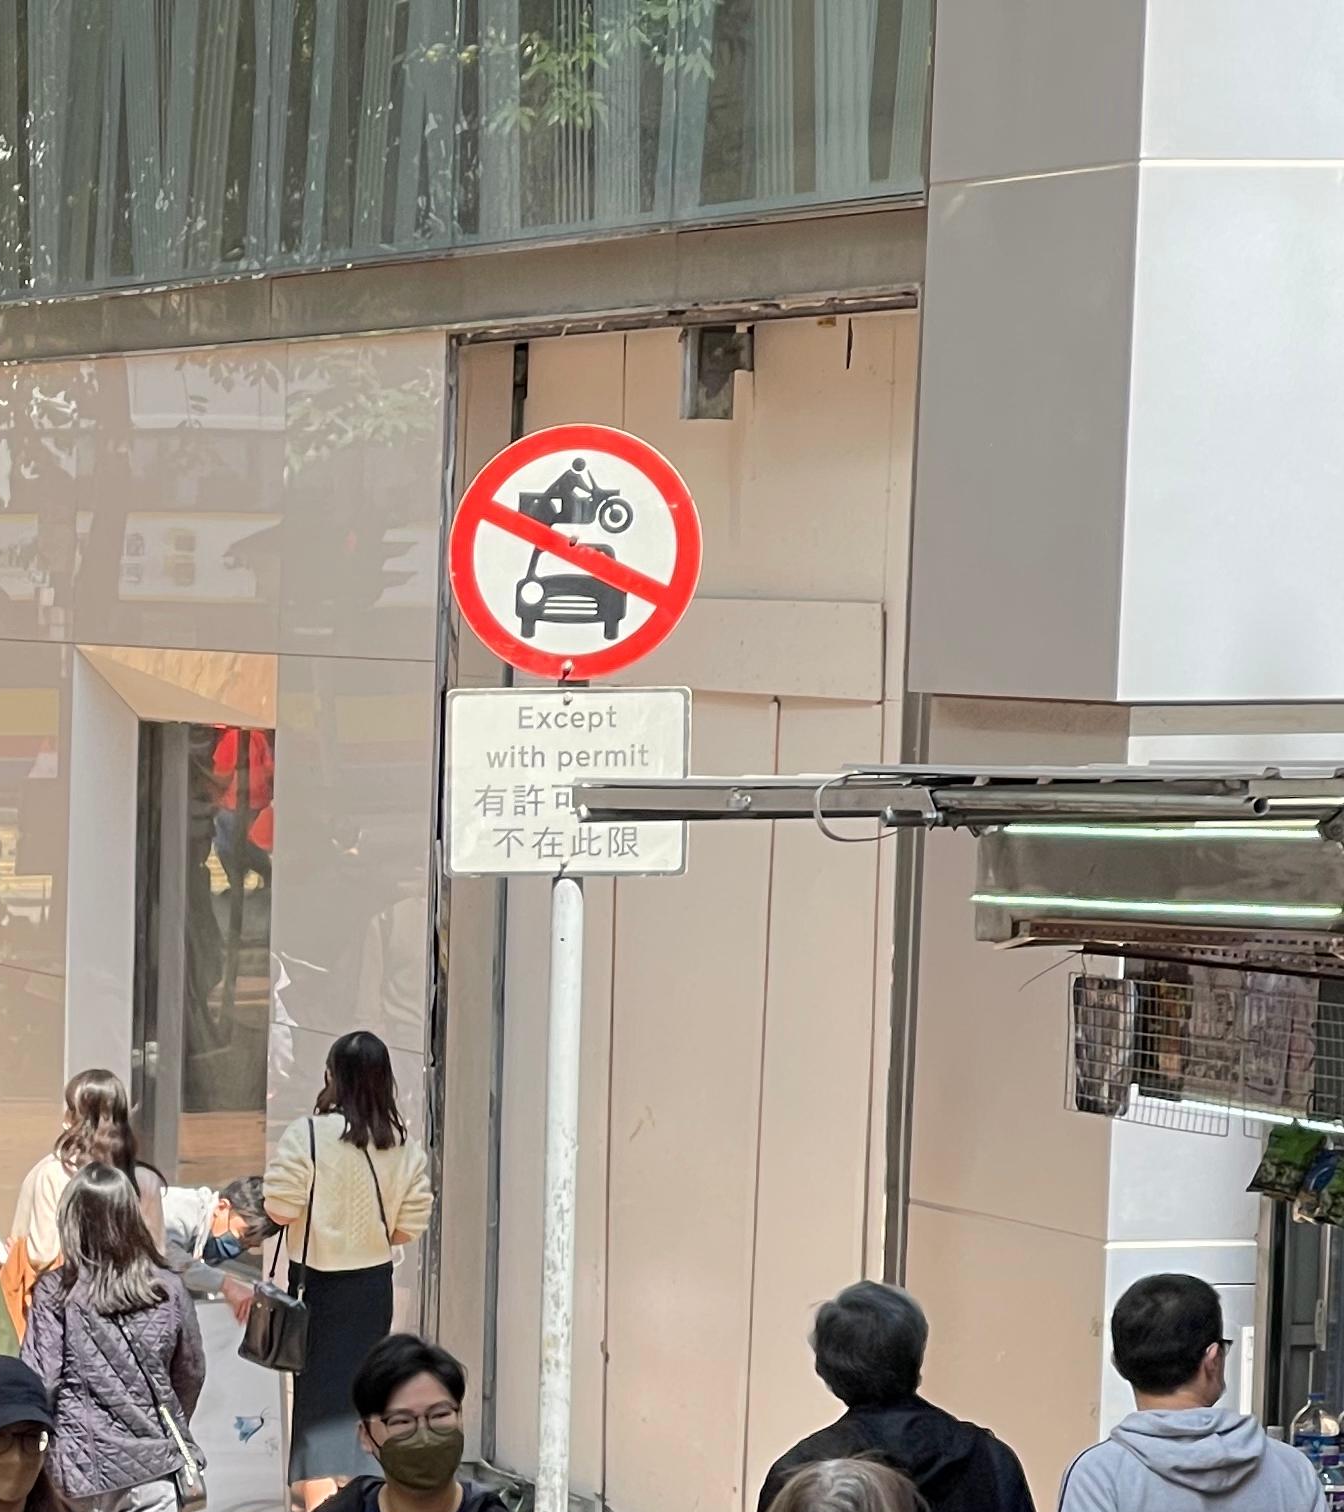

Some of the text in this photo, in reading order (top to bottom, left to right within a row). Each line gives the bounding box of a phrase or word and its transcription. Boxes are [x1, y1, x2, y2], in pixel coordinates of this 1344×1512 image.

[518, 705, 618, 733] Except
[486, 743, 650, 772] with permit
[474, 783, 576, 818] 有許可
[492, 826, 640, 860] 不在此限
